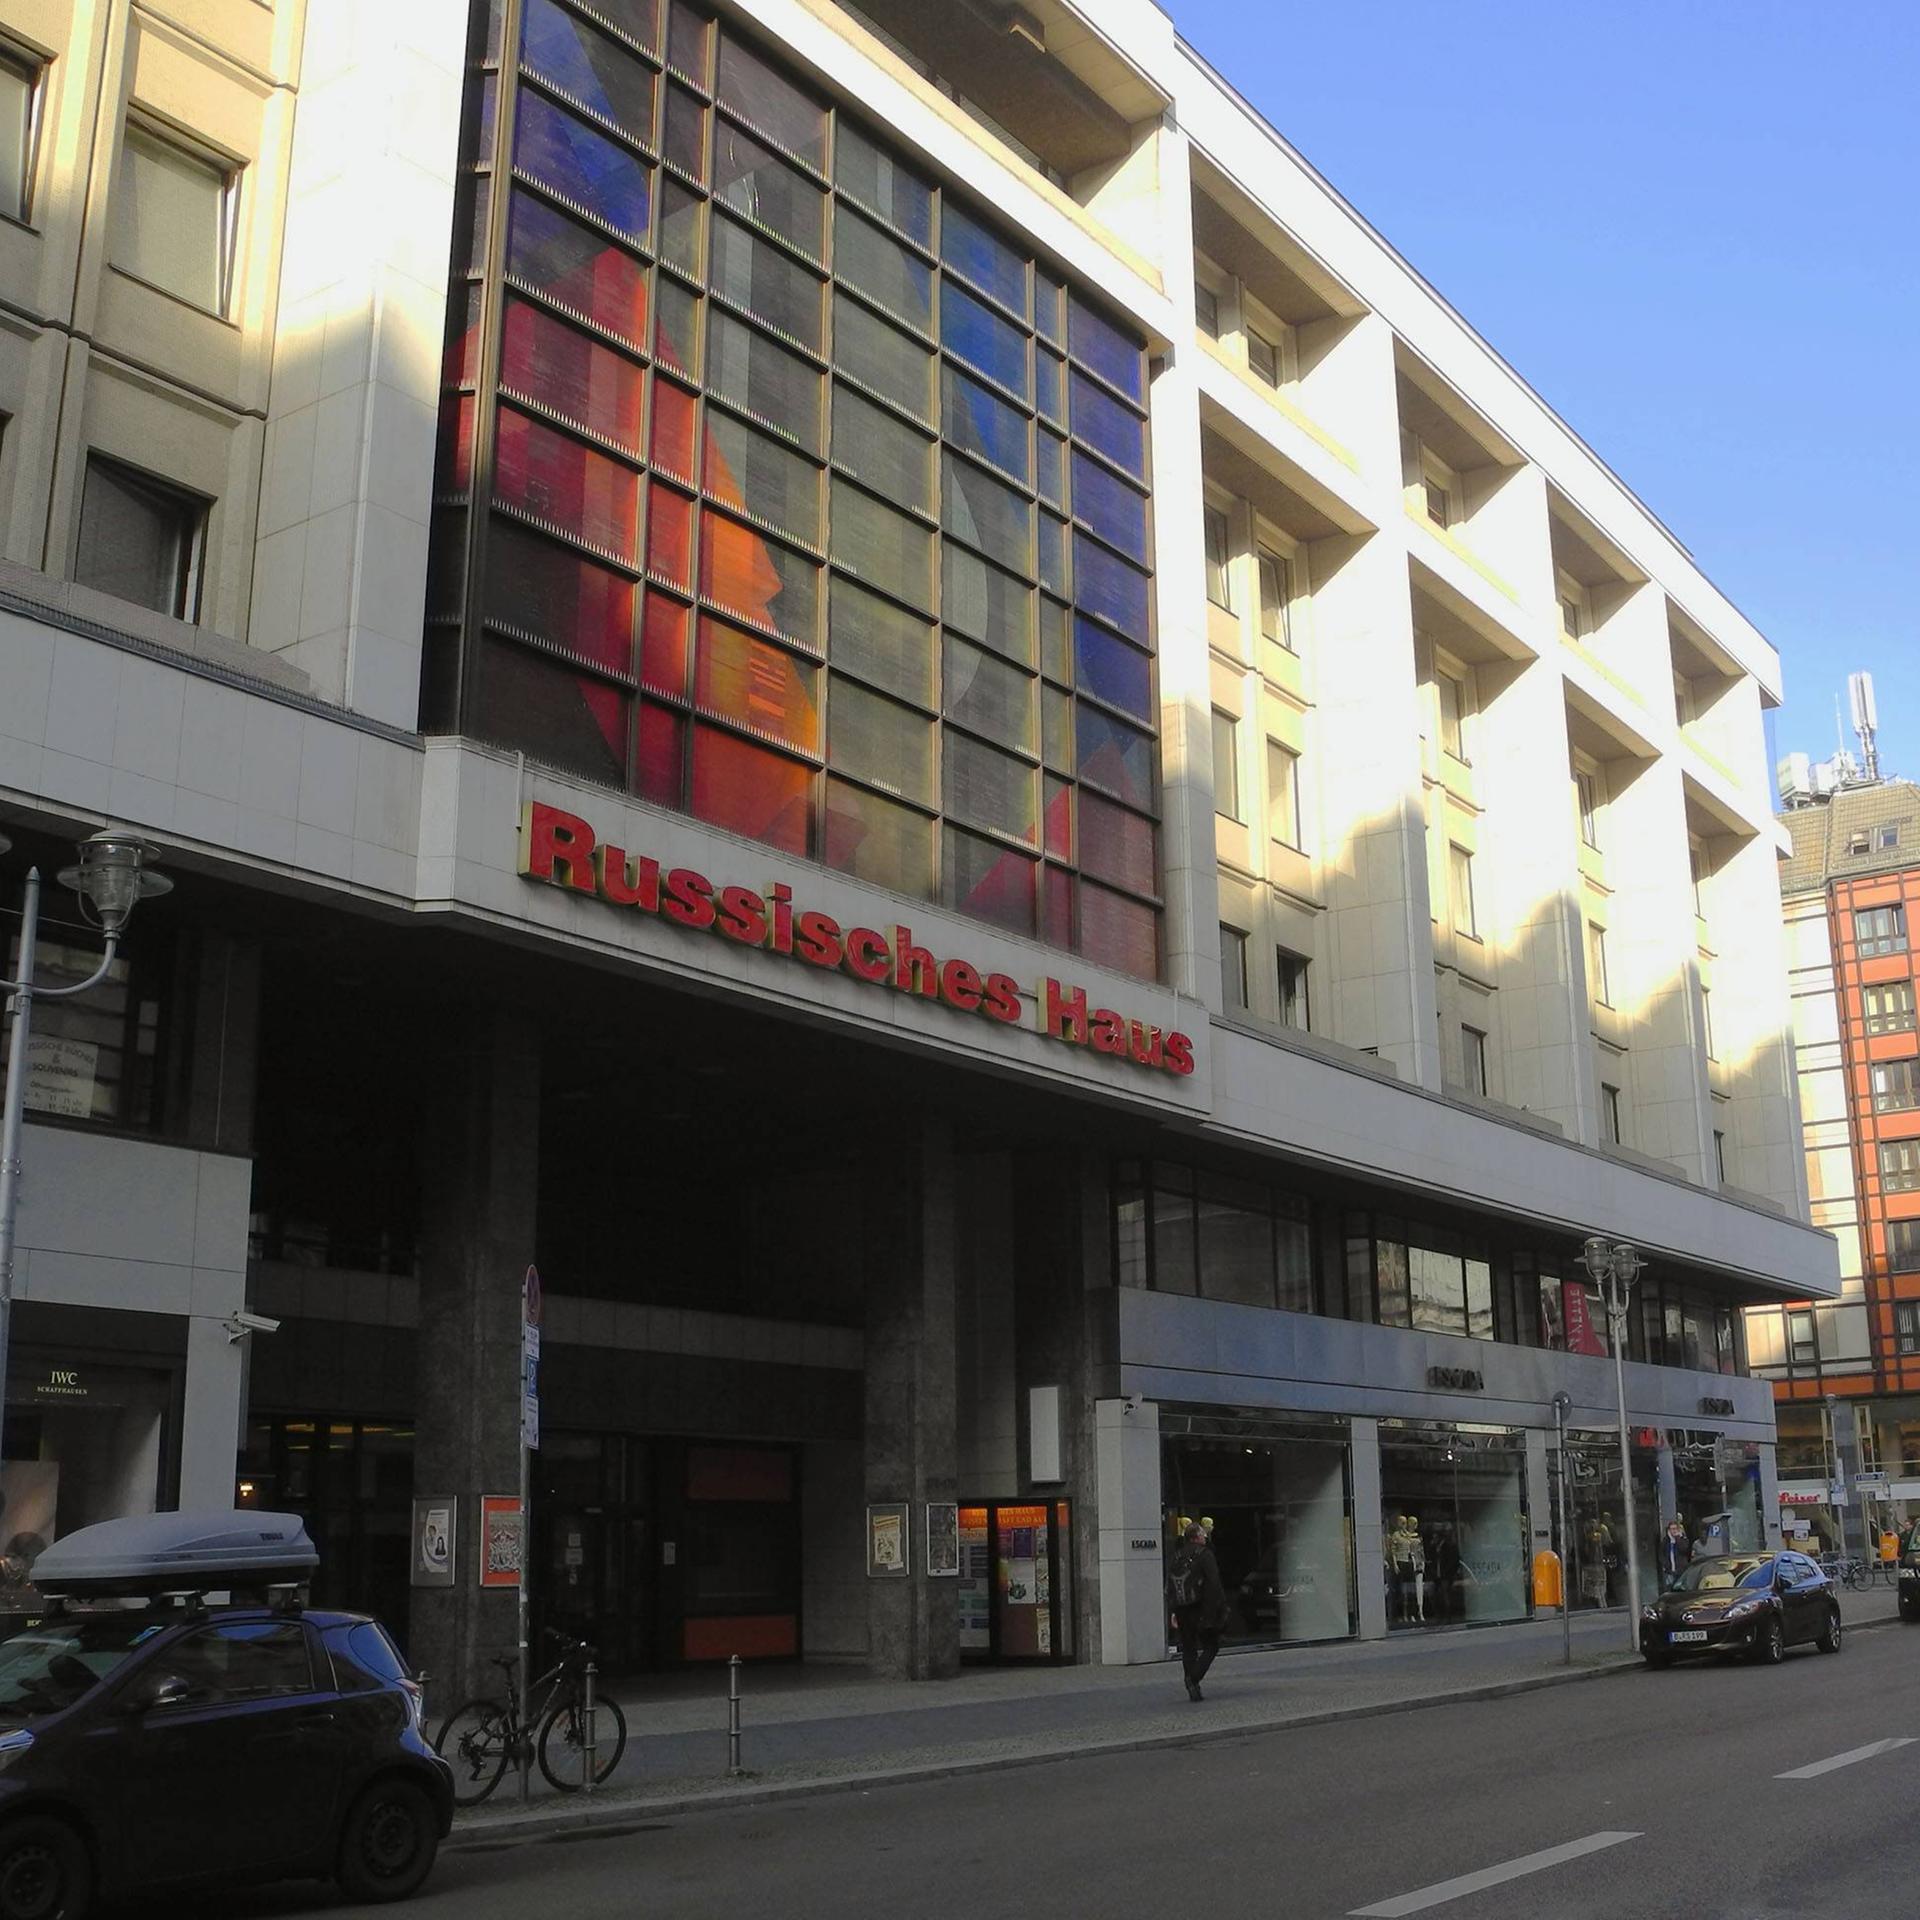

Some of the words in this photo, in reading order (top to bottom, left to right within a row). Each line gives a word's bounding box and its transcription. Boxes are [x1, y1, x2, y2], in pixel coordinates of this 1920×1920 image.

[521, 801, 1022, 1022] Russisches
[1039, 977, 1195, 1076] Haus
[51, 1371, 78, 1385] IWC
[37, 1386, 88, 1395] SCHAFFHAUSEN
[1131, 1540, 1157, 1549] ESCADA
